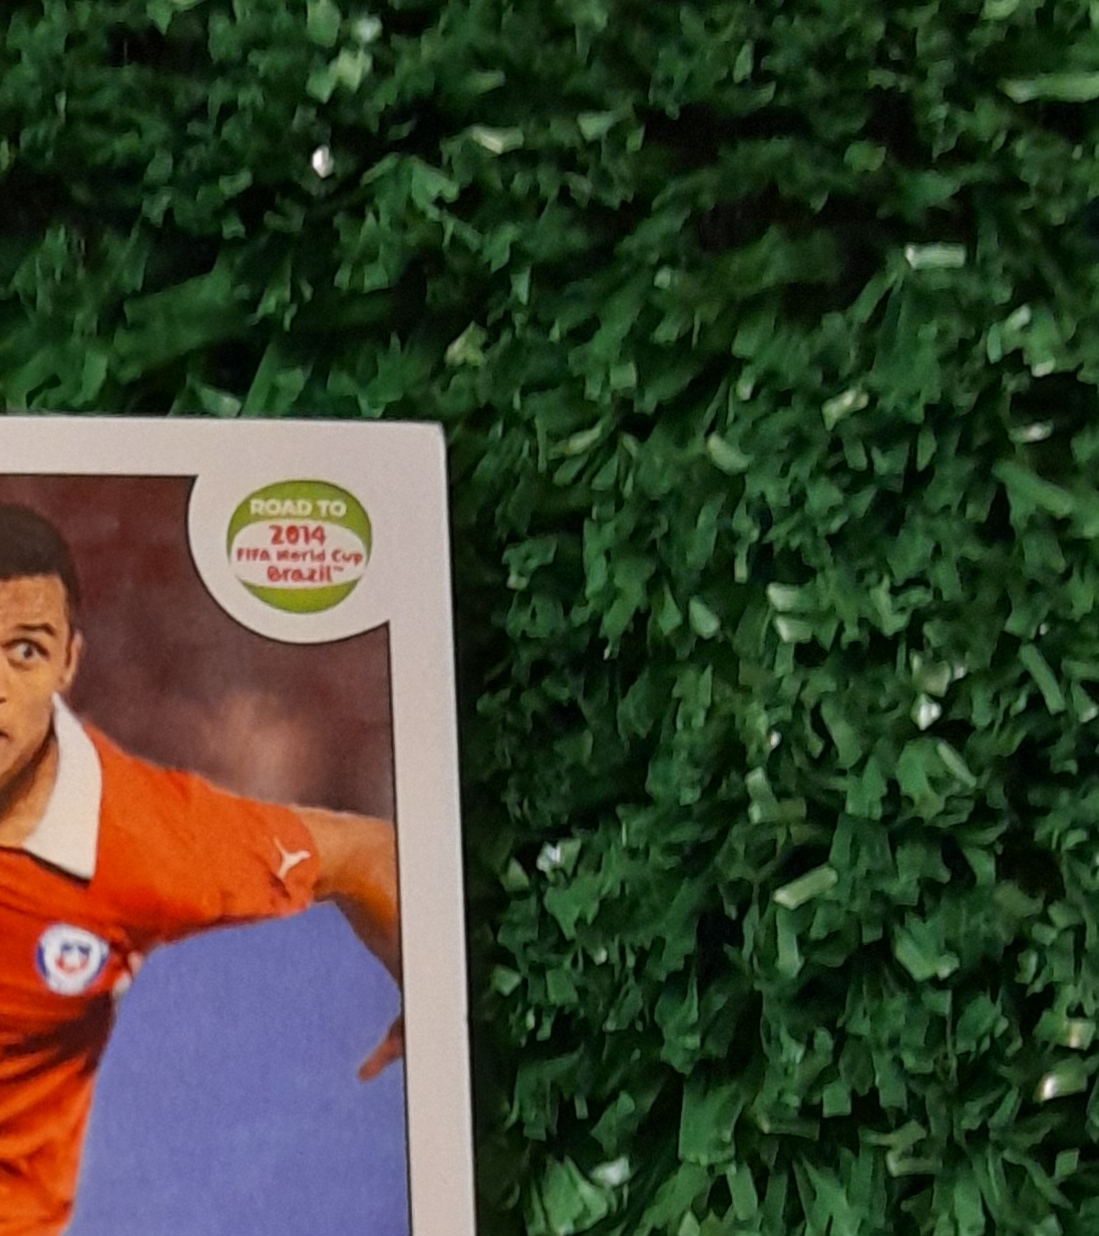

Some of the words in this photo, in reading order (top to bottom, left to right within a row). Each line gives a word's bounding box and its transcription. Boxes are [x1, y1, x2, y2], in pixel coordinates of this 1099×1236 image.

[249, 499, 313, 517] ROAD
[316, 500, 347, 518] TO
[268, 524, 326, 546] 2014
[236, 547, 271, 562] FIFA
[276, 548, 326, 562] World
[331, 549, 364, 566] Cup
